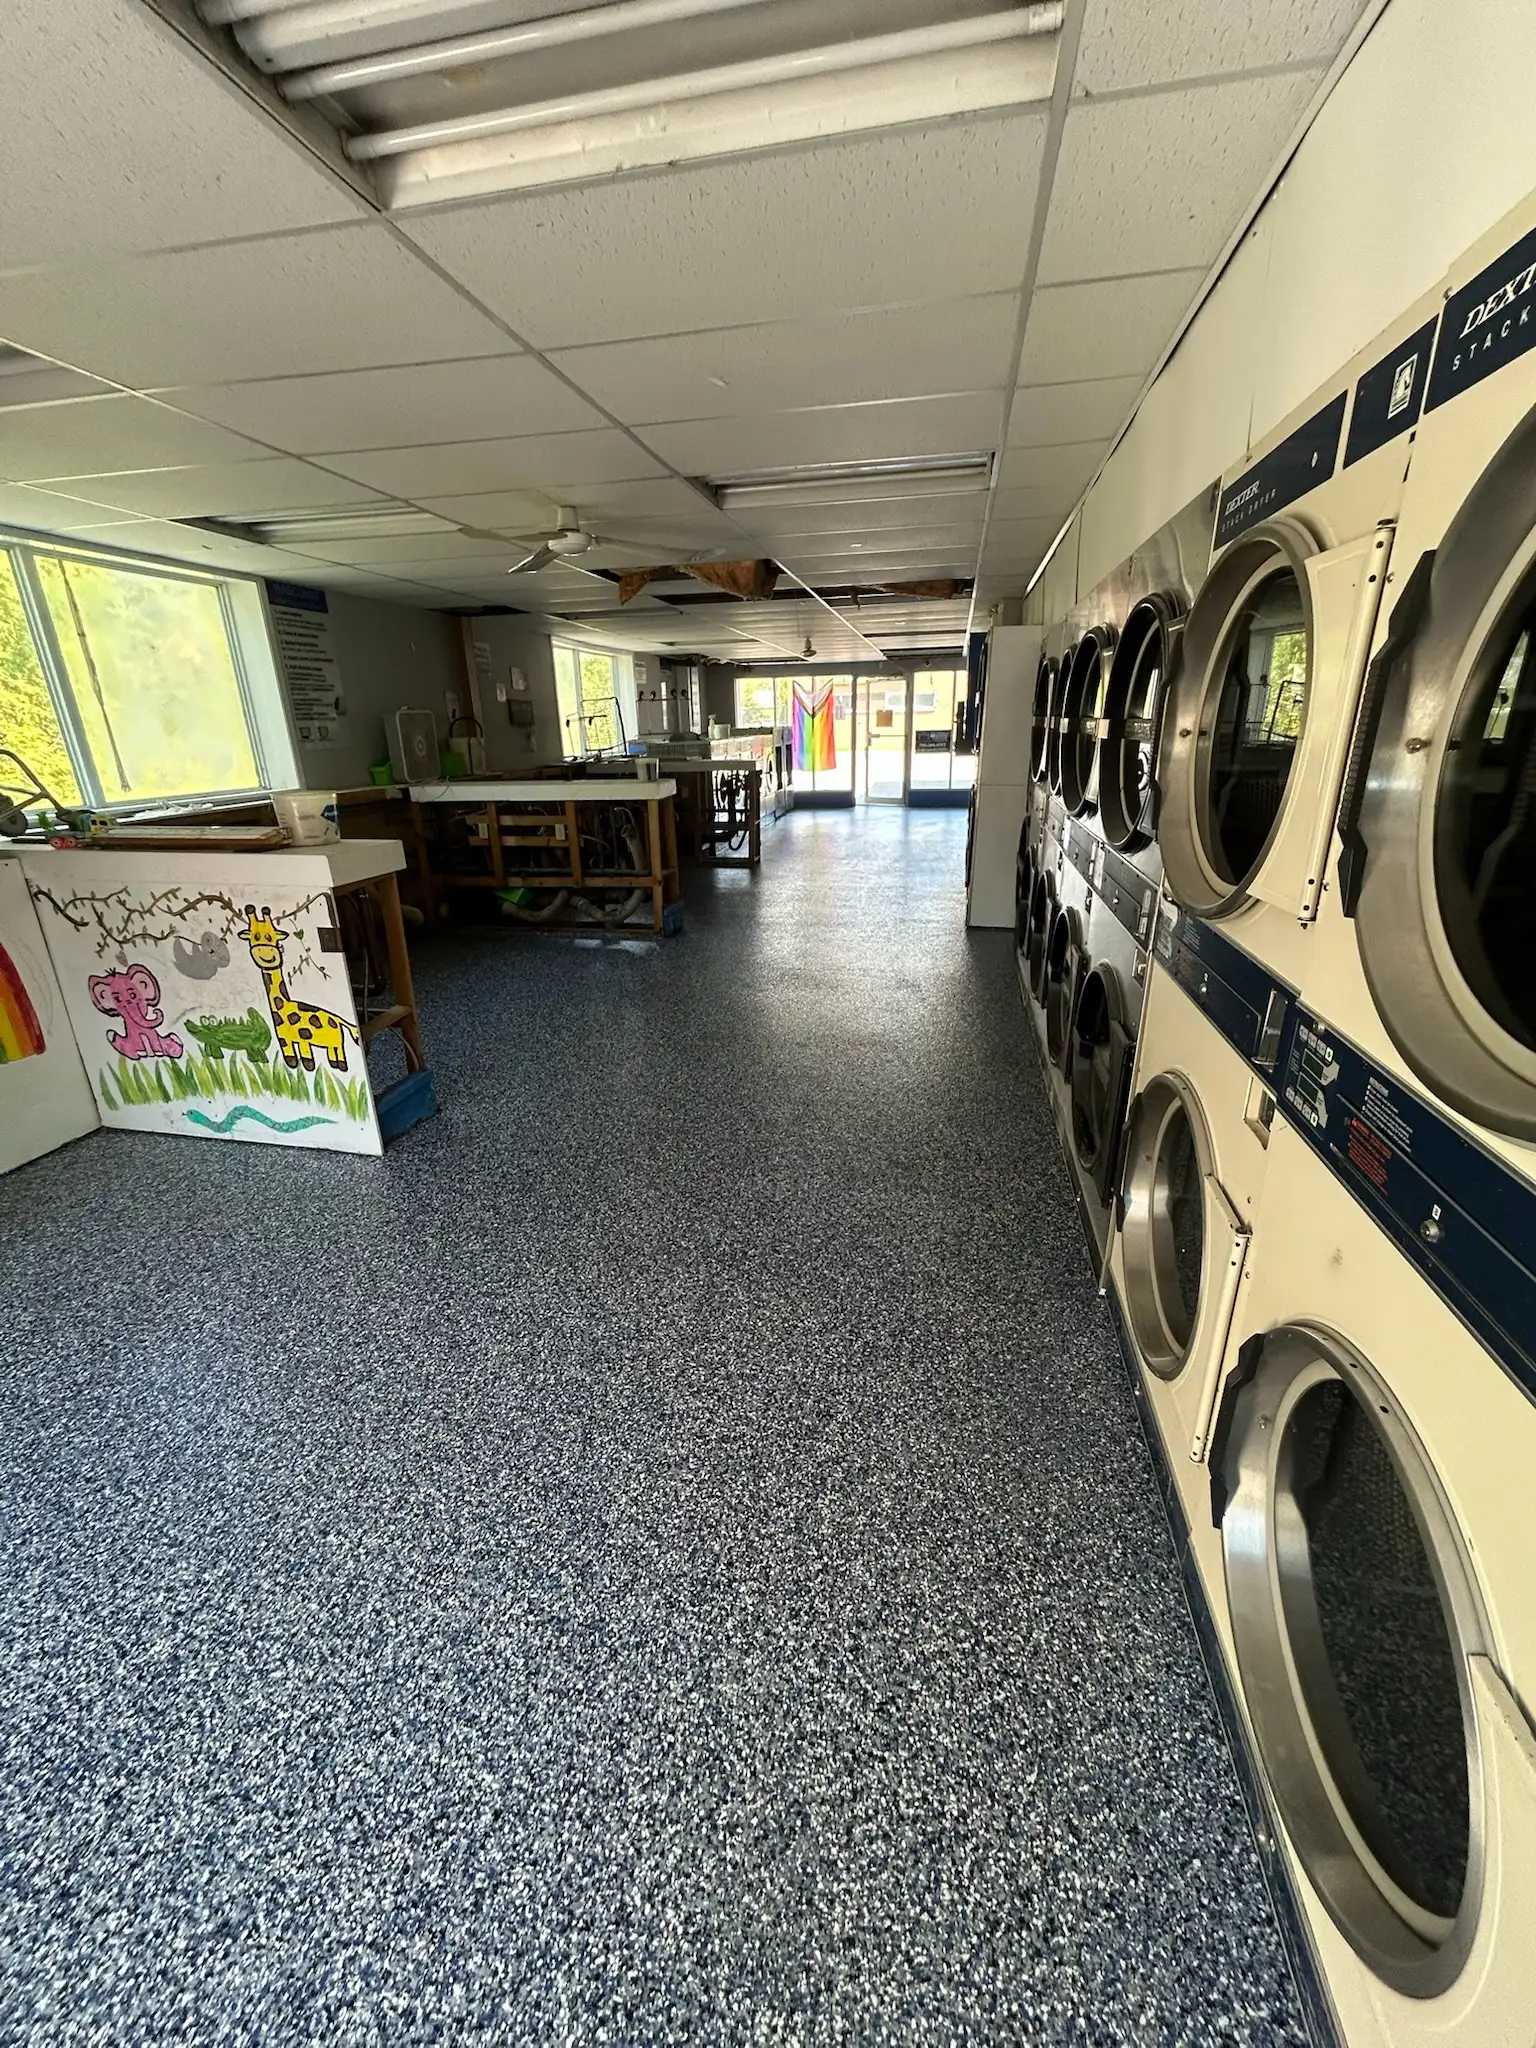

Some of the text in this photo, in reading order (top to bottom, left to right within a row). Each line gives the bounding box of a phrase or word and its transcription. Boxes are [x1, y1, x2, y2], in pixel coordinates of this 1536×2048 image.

[1459, 262, 1536, 339] DEXT
[1452, 304, 1531, 371] STACK
[1224, 480, 1260, 516] DEXTER
